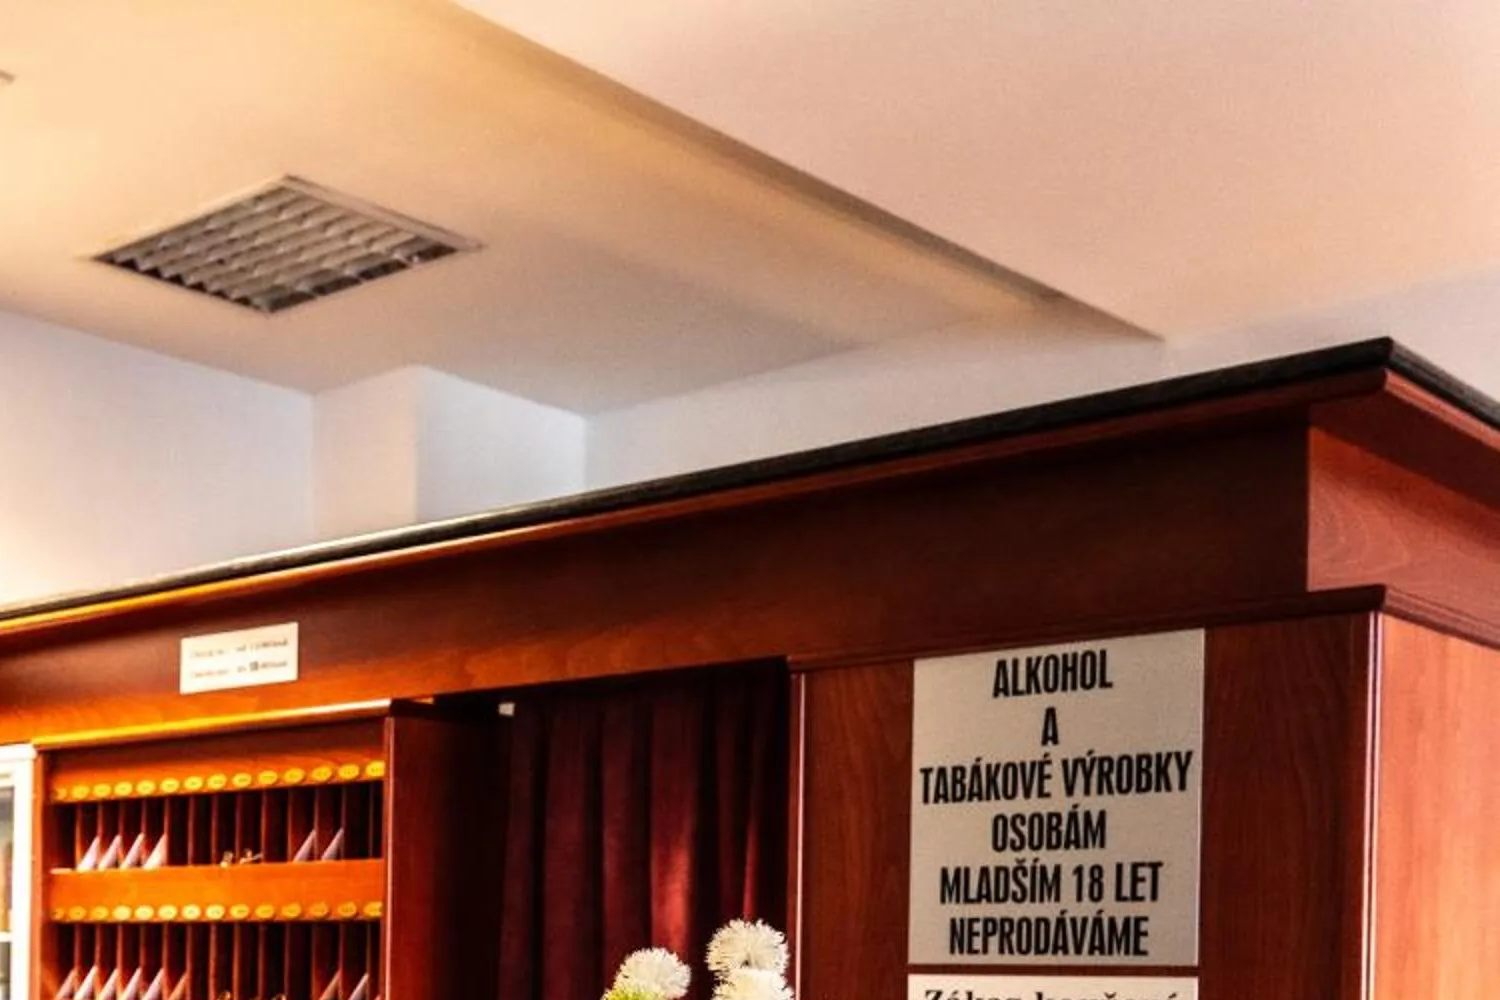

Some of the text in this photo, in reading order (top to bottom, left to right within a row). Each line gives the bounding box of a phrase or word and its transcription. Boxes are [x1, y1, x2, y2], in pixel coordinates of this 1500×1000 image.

[993, 649, 1113, 698] ALKOHOL
[1041, 707, 1059, 747] A
[920, 750, 1193, 804] TABÁKOVÉ VÝROBKY
[991, 804, 1107, 852] OSOBÁM
[940, 858, 1163, 904] MLADŠÍM 18 LET
[949, 909, 1149, 957] NEPRODÁVÁME
